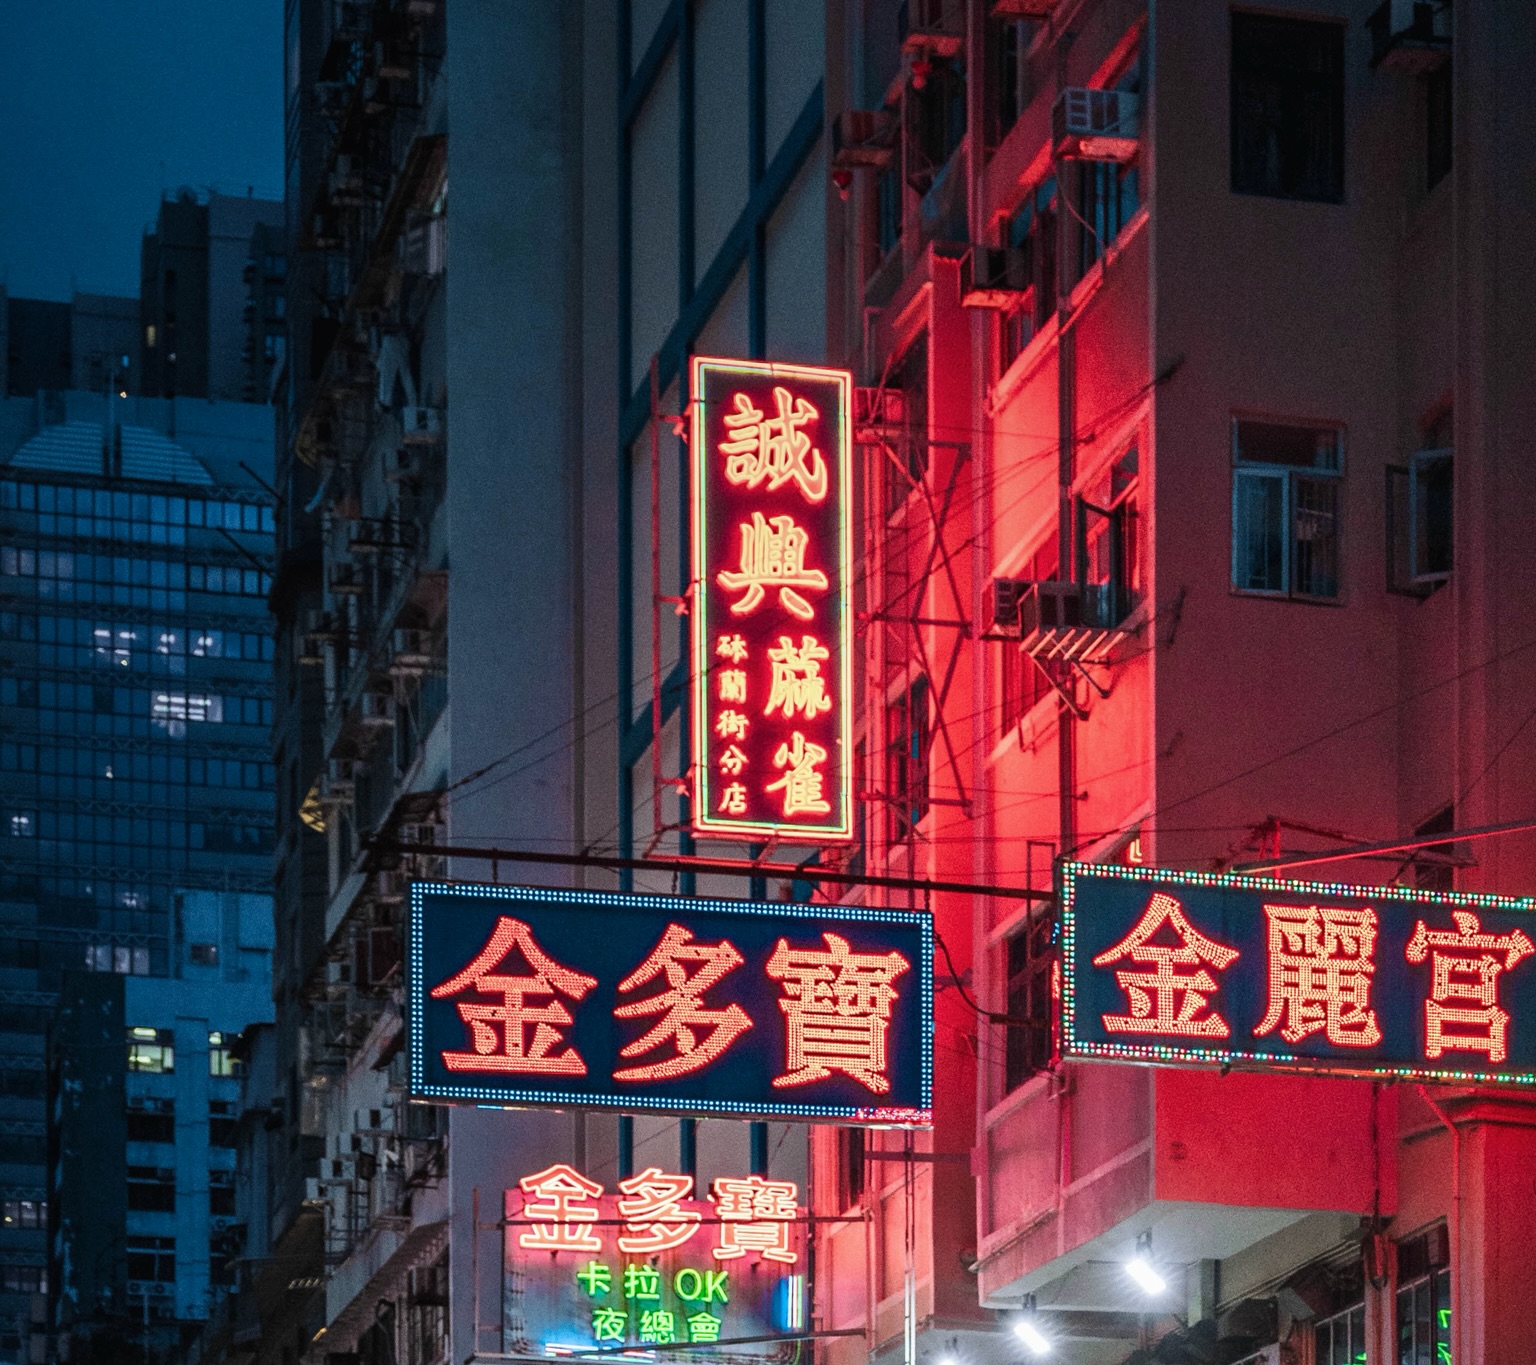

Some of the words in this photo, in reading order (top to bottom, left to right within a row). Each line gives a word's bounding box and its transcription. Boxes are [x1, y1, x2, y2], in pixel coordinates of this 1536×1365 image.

[430, 915, 910, 1094] 金多寶
[1092, 893, 1536, 1064] 金麗宮
[519, 1164, 798, 1264] 金多寶
[591, 1309, 722, 1345] 夜總會
